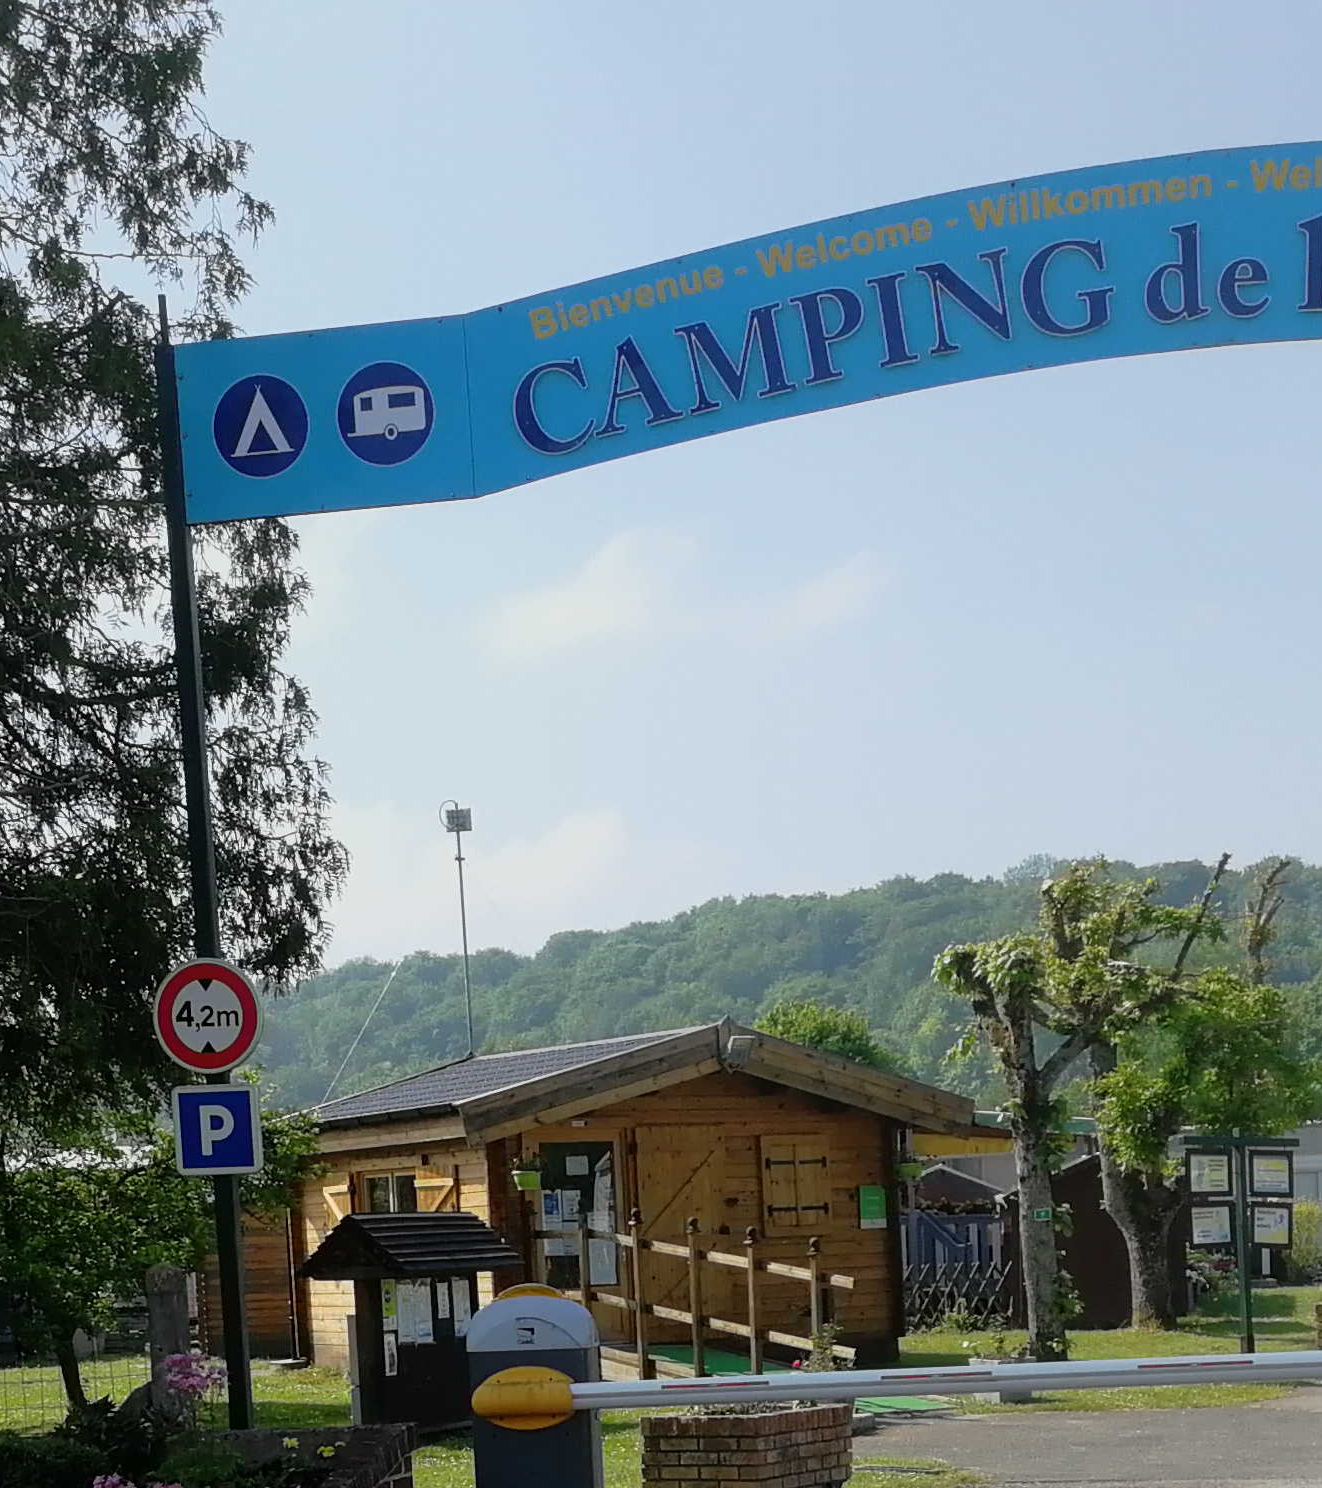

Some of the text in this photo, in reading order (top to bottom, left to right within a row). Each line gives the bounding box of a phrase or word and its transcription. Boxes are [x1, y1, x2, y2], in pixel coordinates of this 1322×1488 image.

[528, 264, 725, 341] Bienvenue
[756, 213, 933, 278] Welcome
[968, 174, 1213, 231] Willkommen
[513, 238, 1116, 456] CAMPING
[1144, 220, 1271, 324] de
[175, 1000, 240, 1033] 4,2m
[198, 1104, 235, 1157] P
